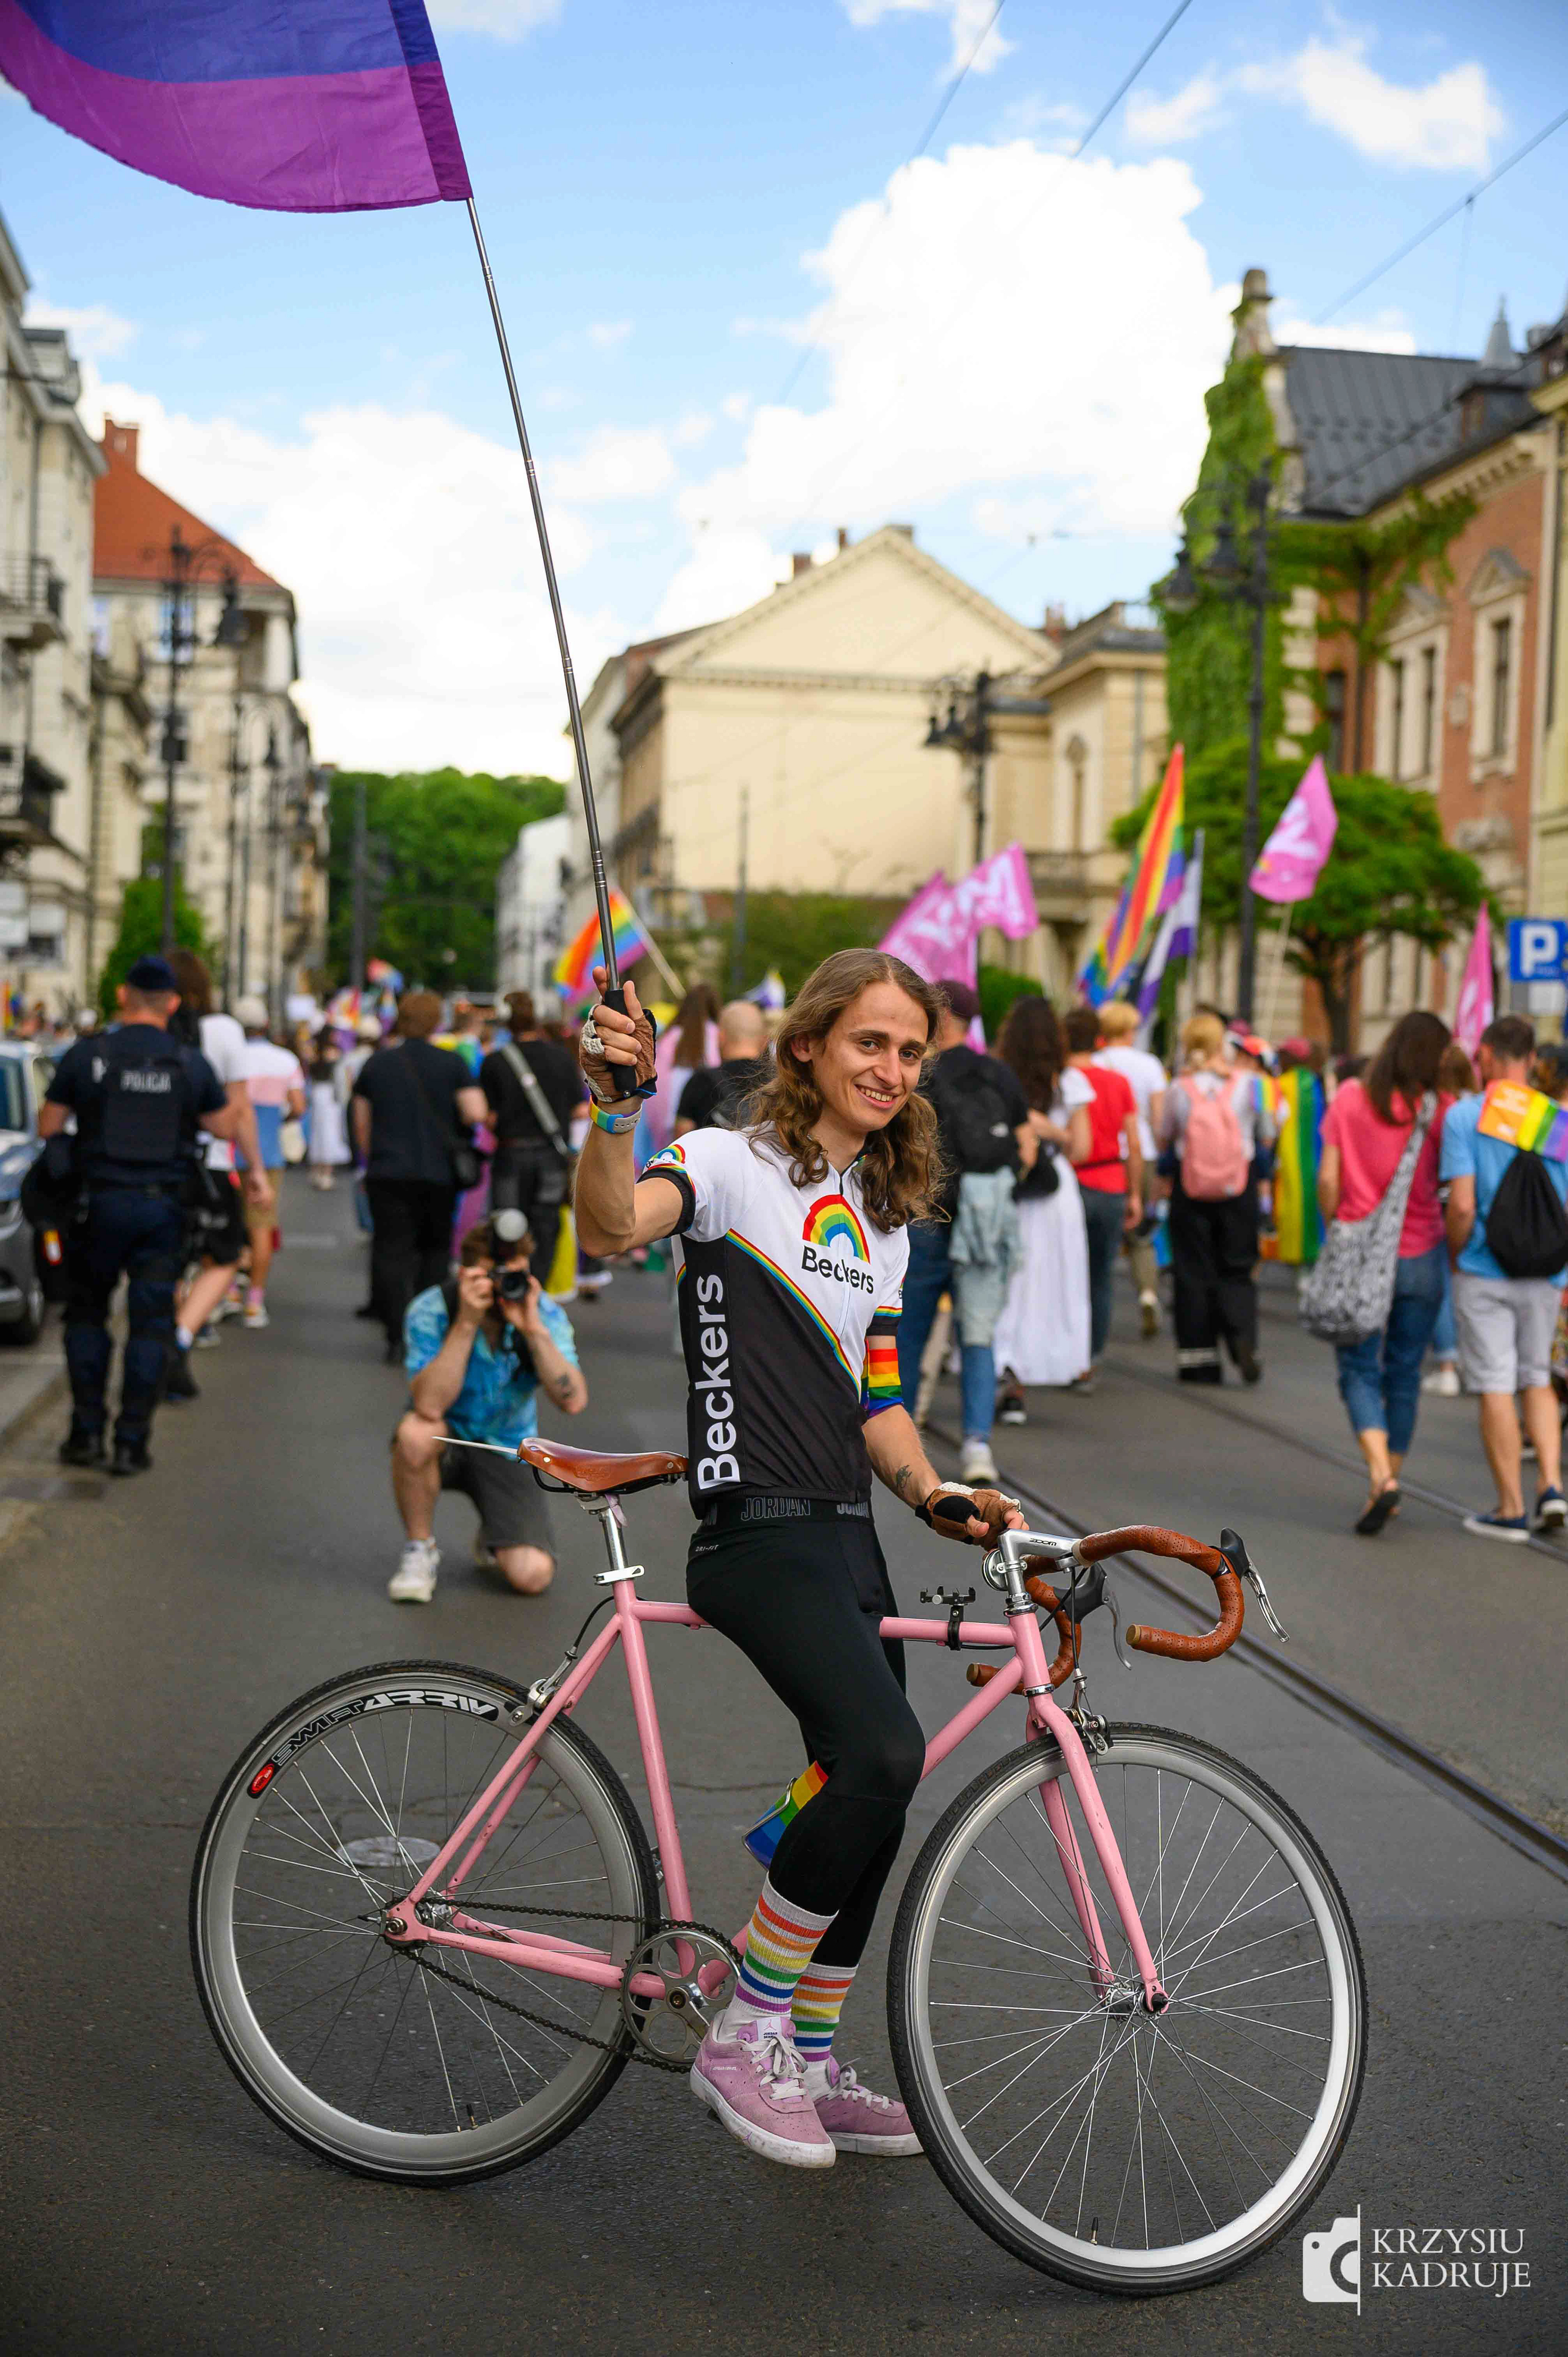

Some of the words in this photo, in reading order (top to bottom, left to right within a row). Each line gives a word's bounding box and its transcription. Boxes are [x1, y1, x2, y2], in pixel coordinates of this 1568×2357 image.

[1520, 924, 1559, 978] P
[801, 1245, 874, 1294] Beckers
[695, 1274, 741, 1490] Beckers
[740, 1496, 811, 1521] JORDAN
[363, 1690, 496, 1715] ARRIV
